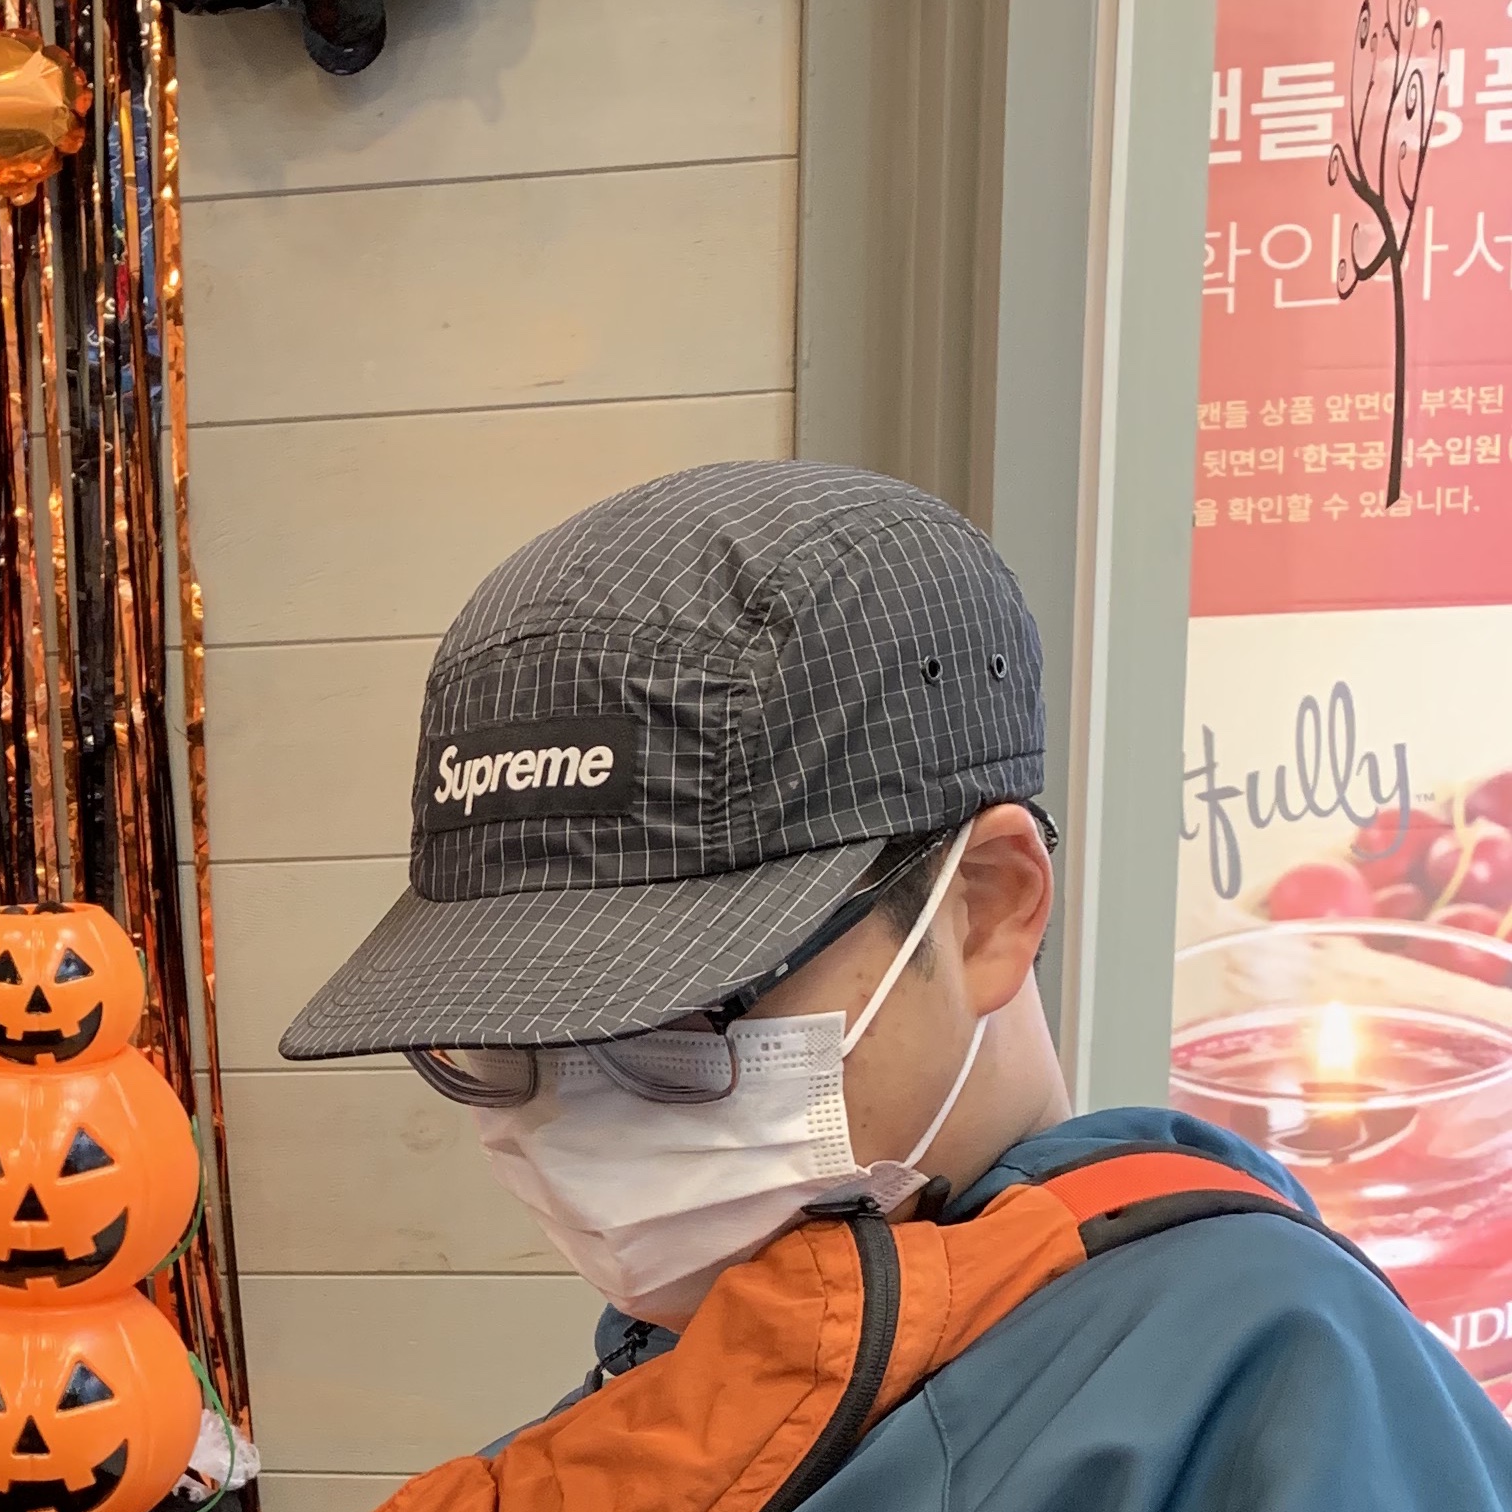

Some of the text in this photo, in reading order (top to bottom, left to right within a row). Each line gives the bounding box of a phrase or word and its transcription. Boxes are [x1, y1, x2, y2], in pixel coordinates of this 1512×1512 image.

[1258, 394, 1316, 427] 상품
[1419, 384, 1505, 418] 부착된
[1202, 446, 1285, 478] 뒷면의
[1228, 491, 1314, 526] 확인할
[1321, 492, 1350, 522] 수
[434, 744, 614, 817] Supreme
